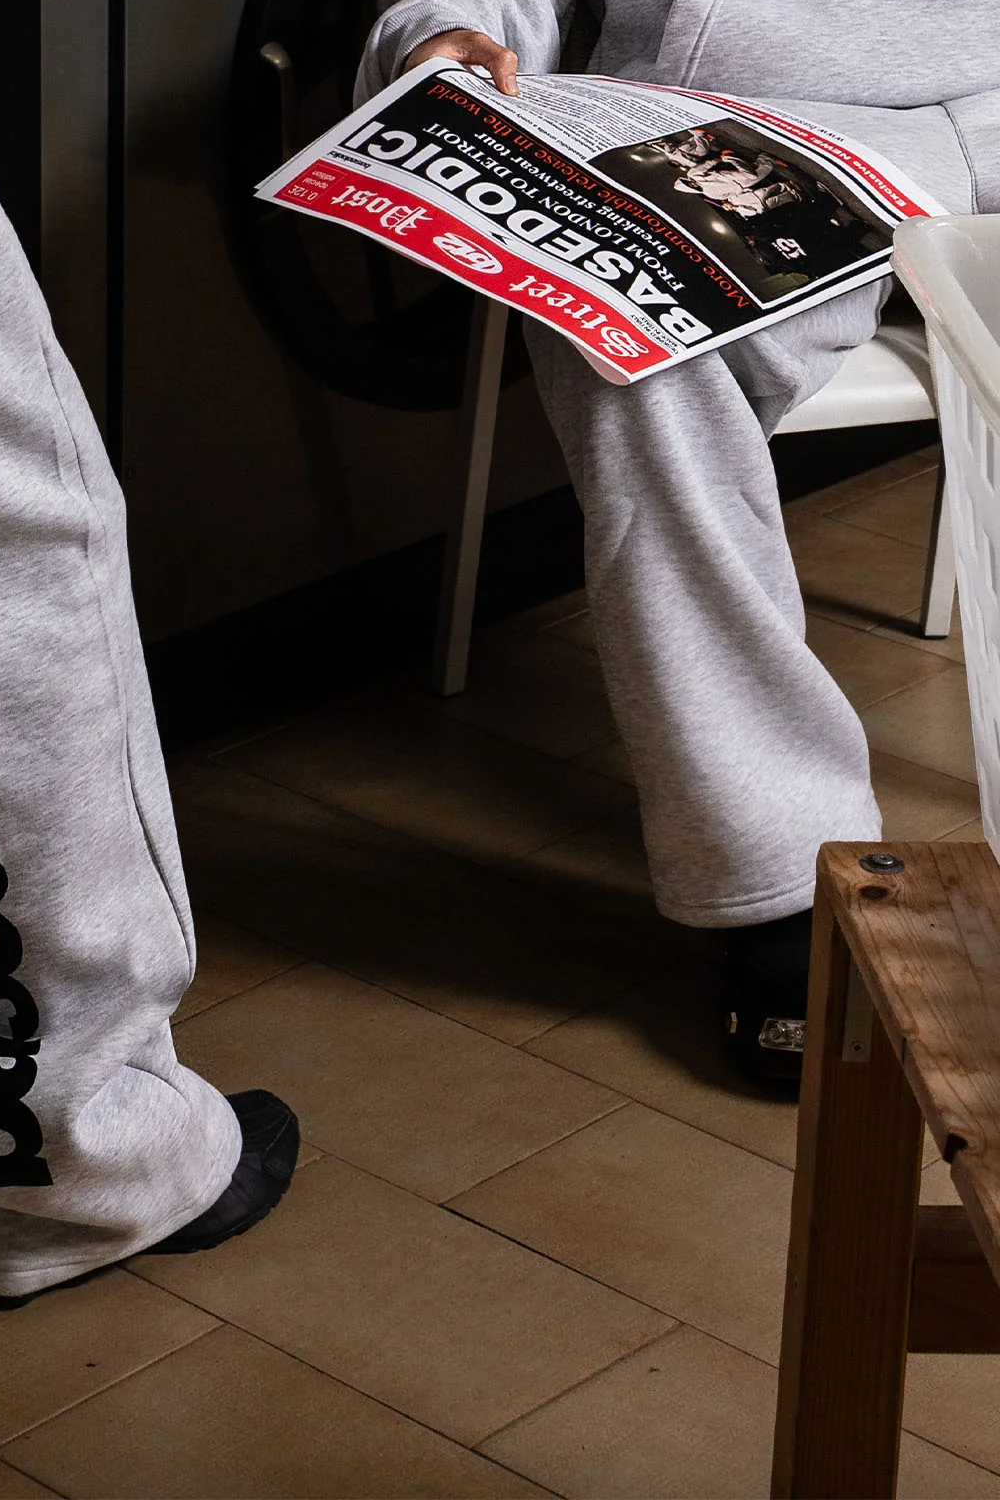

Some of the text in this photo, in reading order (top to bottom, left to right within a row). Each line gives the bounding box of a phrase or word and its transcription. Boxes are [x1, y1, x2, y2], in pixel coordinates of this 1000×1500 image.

[427, 82, 479, 115] world
[478, 113, 513, 133] the
[513, 134, 534, 150] in
[765, 115, 809, 136] details
[422, 121, 513, 179] DETROIT
[529, 147, 597, 191] release
[302, 176, 329, 190] special
[311, 170, 336, 182] edition
[473, 133, 670, 257] breaking streetwear tour
[511, 179, 537, 199] TO
[853, 161, 907, 207] Exclusive
[331, 183, 433, 238] Post
[344, 120, 713, 346] BASEDODICI
[539, 196, 628, 247] LONDON
[597, 190, 701, 262] comfortable
[623, 242, 686, 293] FROM
[703, 265, 750, 309] More
[508, 275, 649, 355] Street
